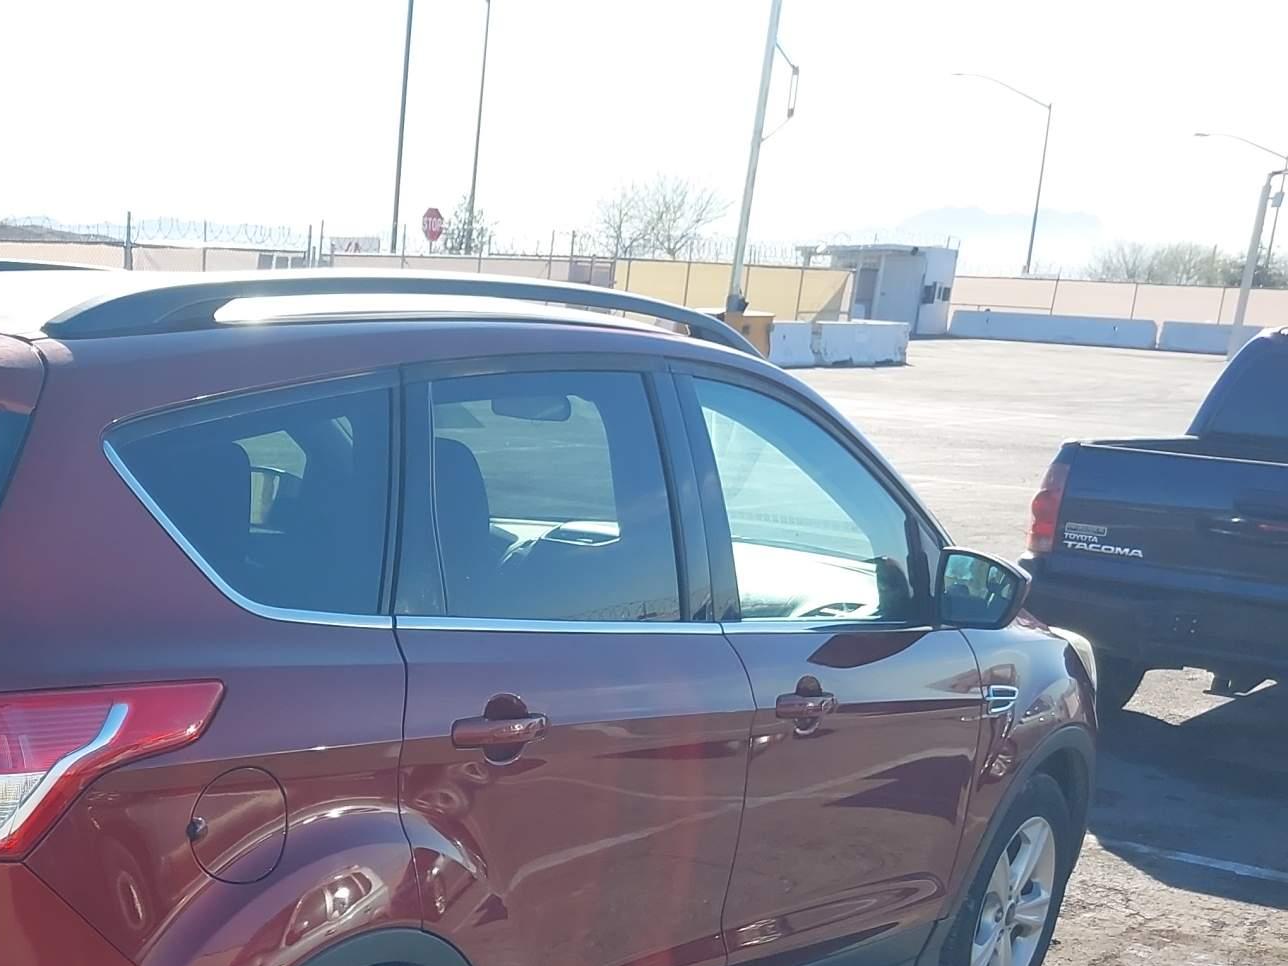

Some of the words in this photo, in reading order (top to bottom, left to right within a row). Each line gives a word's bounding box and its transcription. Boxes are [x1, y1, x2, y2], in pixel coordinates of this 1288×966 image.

[423, 216, 442, 231] STOP
[1064, 532, 1098, 543] TOYOTA
[1063, 540, 1143, 557] TACOMA
